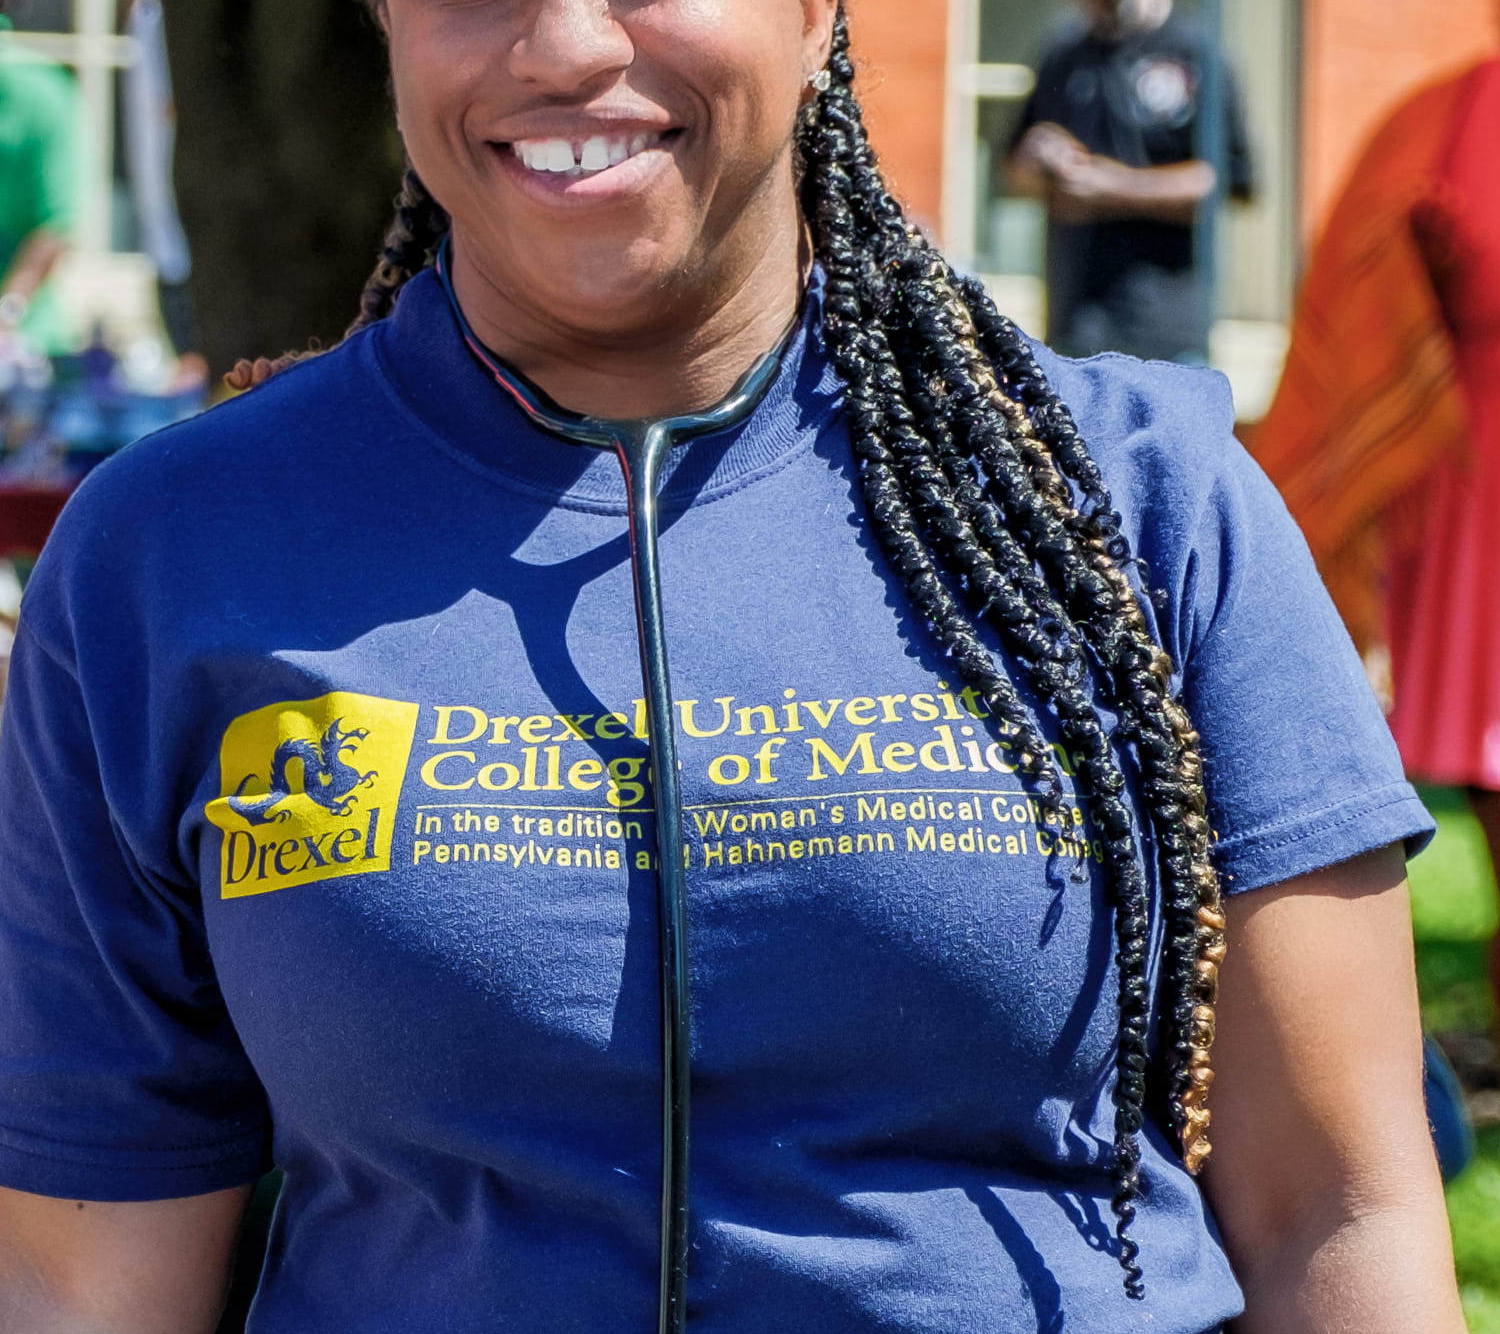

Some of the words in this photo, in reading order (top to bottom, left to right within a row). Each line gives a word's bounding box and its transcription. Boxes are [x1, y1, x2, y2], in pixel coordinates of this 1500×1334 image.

[426, 698, 649, 745] Drexel
[675, 680, 1009, 738] Universit
[419, 746, 682, 807] Colleg
[708, 737, 787, 785] of
[225, 808, 379, 885] Drexel
[413, 840, 621, 869] Pennsylvania
[704, 832, 895, 868] Hahnemann
[906, 826, 1028, 855] Medical
[414, 812, 442, 835] In
[451, 810, 501, 834] the
[511, 812, 643, 840] tradition
[693, 802, 845, 837] Woman's
[857, 796, 983, 822] Medical
